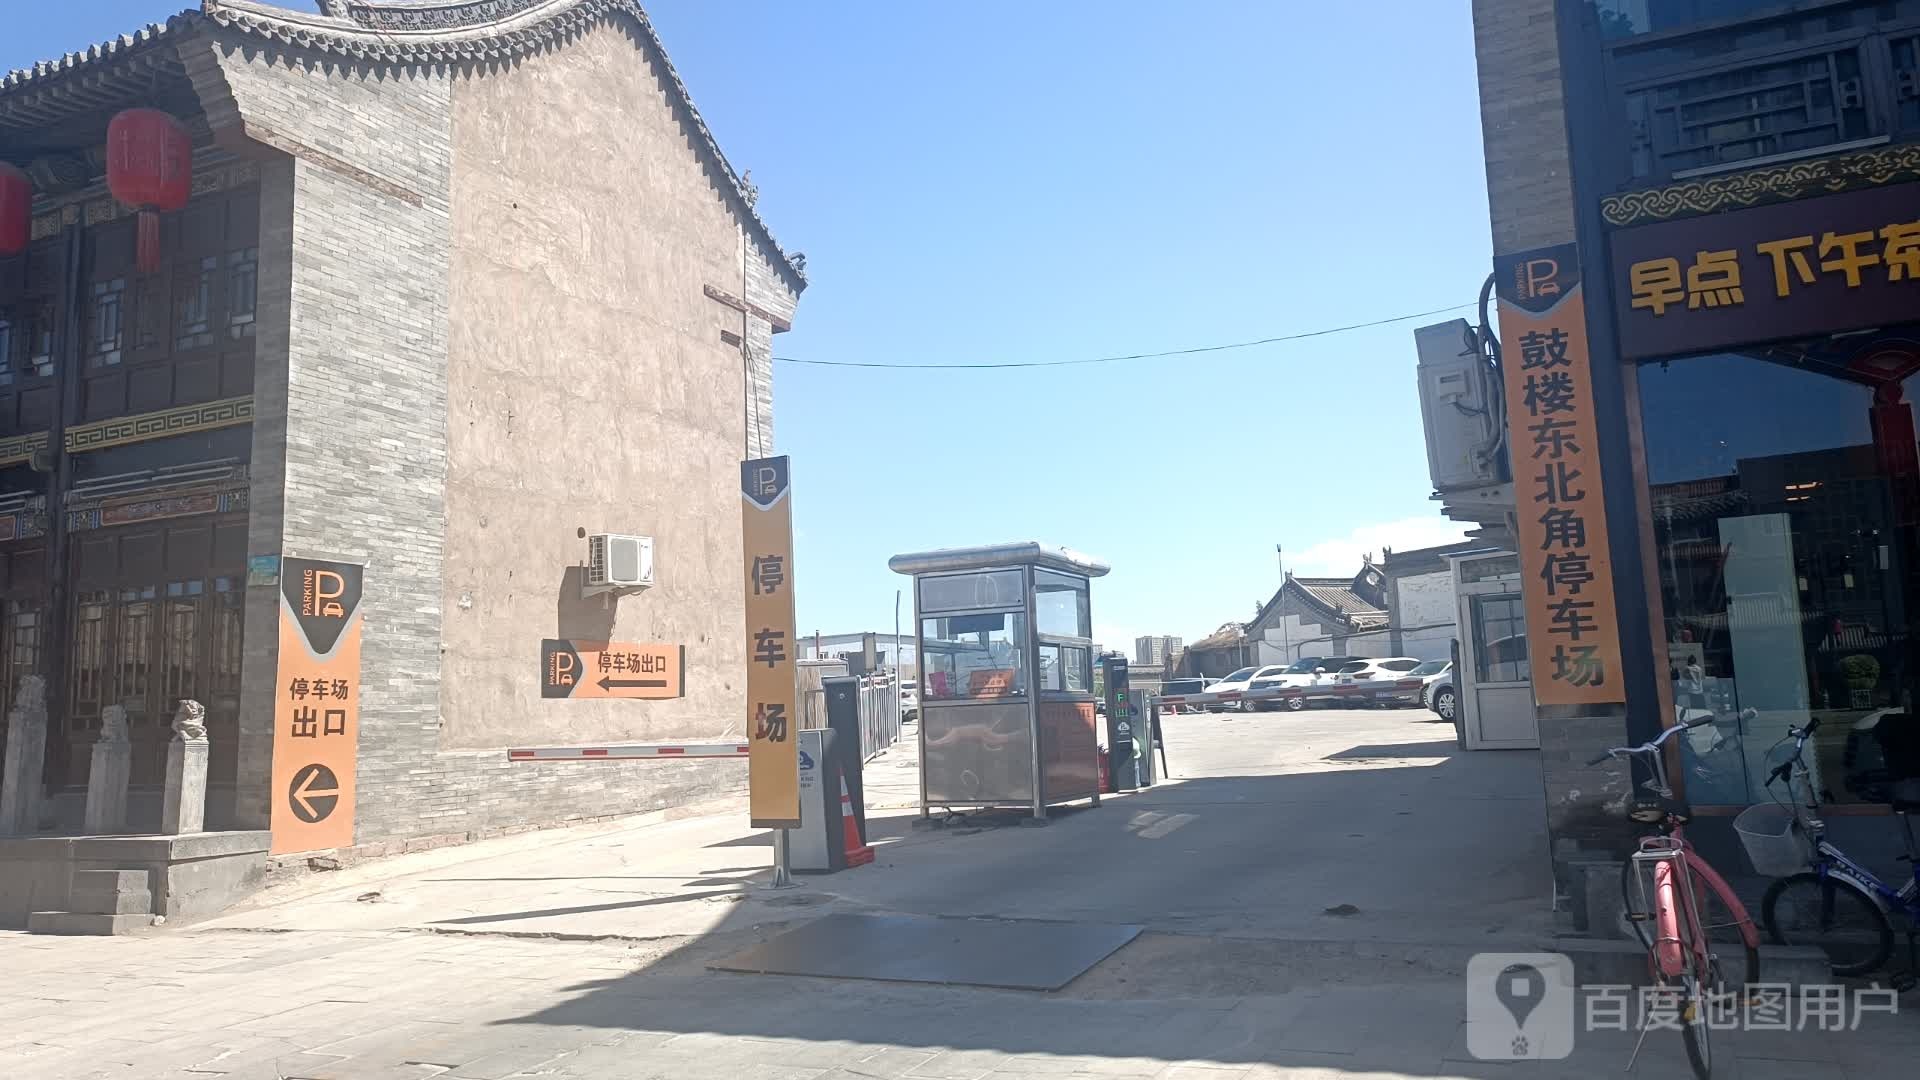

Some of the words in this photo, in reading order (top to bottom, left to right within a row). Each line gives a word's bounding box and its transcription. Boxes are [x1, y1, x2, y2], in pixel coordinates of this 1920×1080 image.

[1630, 250, 1745, 316] 早点
[1756, 219, 1920, 298] 下午茶
[1518, 327, 1605, 688] 鼓楼东北角停车场
[303, 569, 313, 617] PARKING
[597, 652, 667, 674] 停车场出口
[751, 555, 786, 743] 停车场
[289, 678, 349, 701] 停车场
[291, 705, 346, 739] 出口
